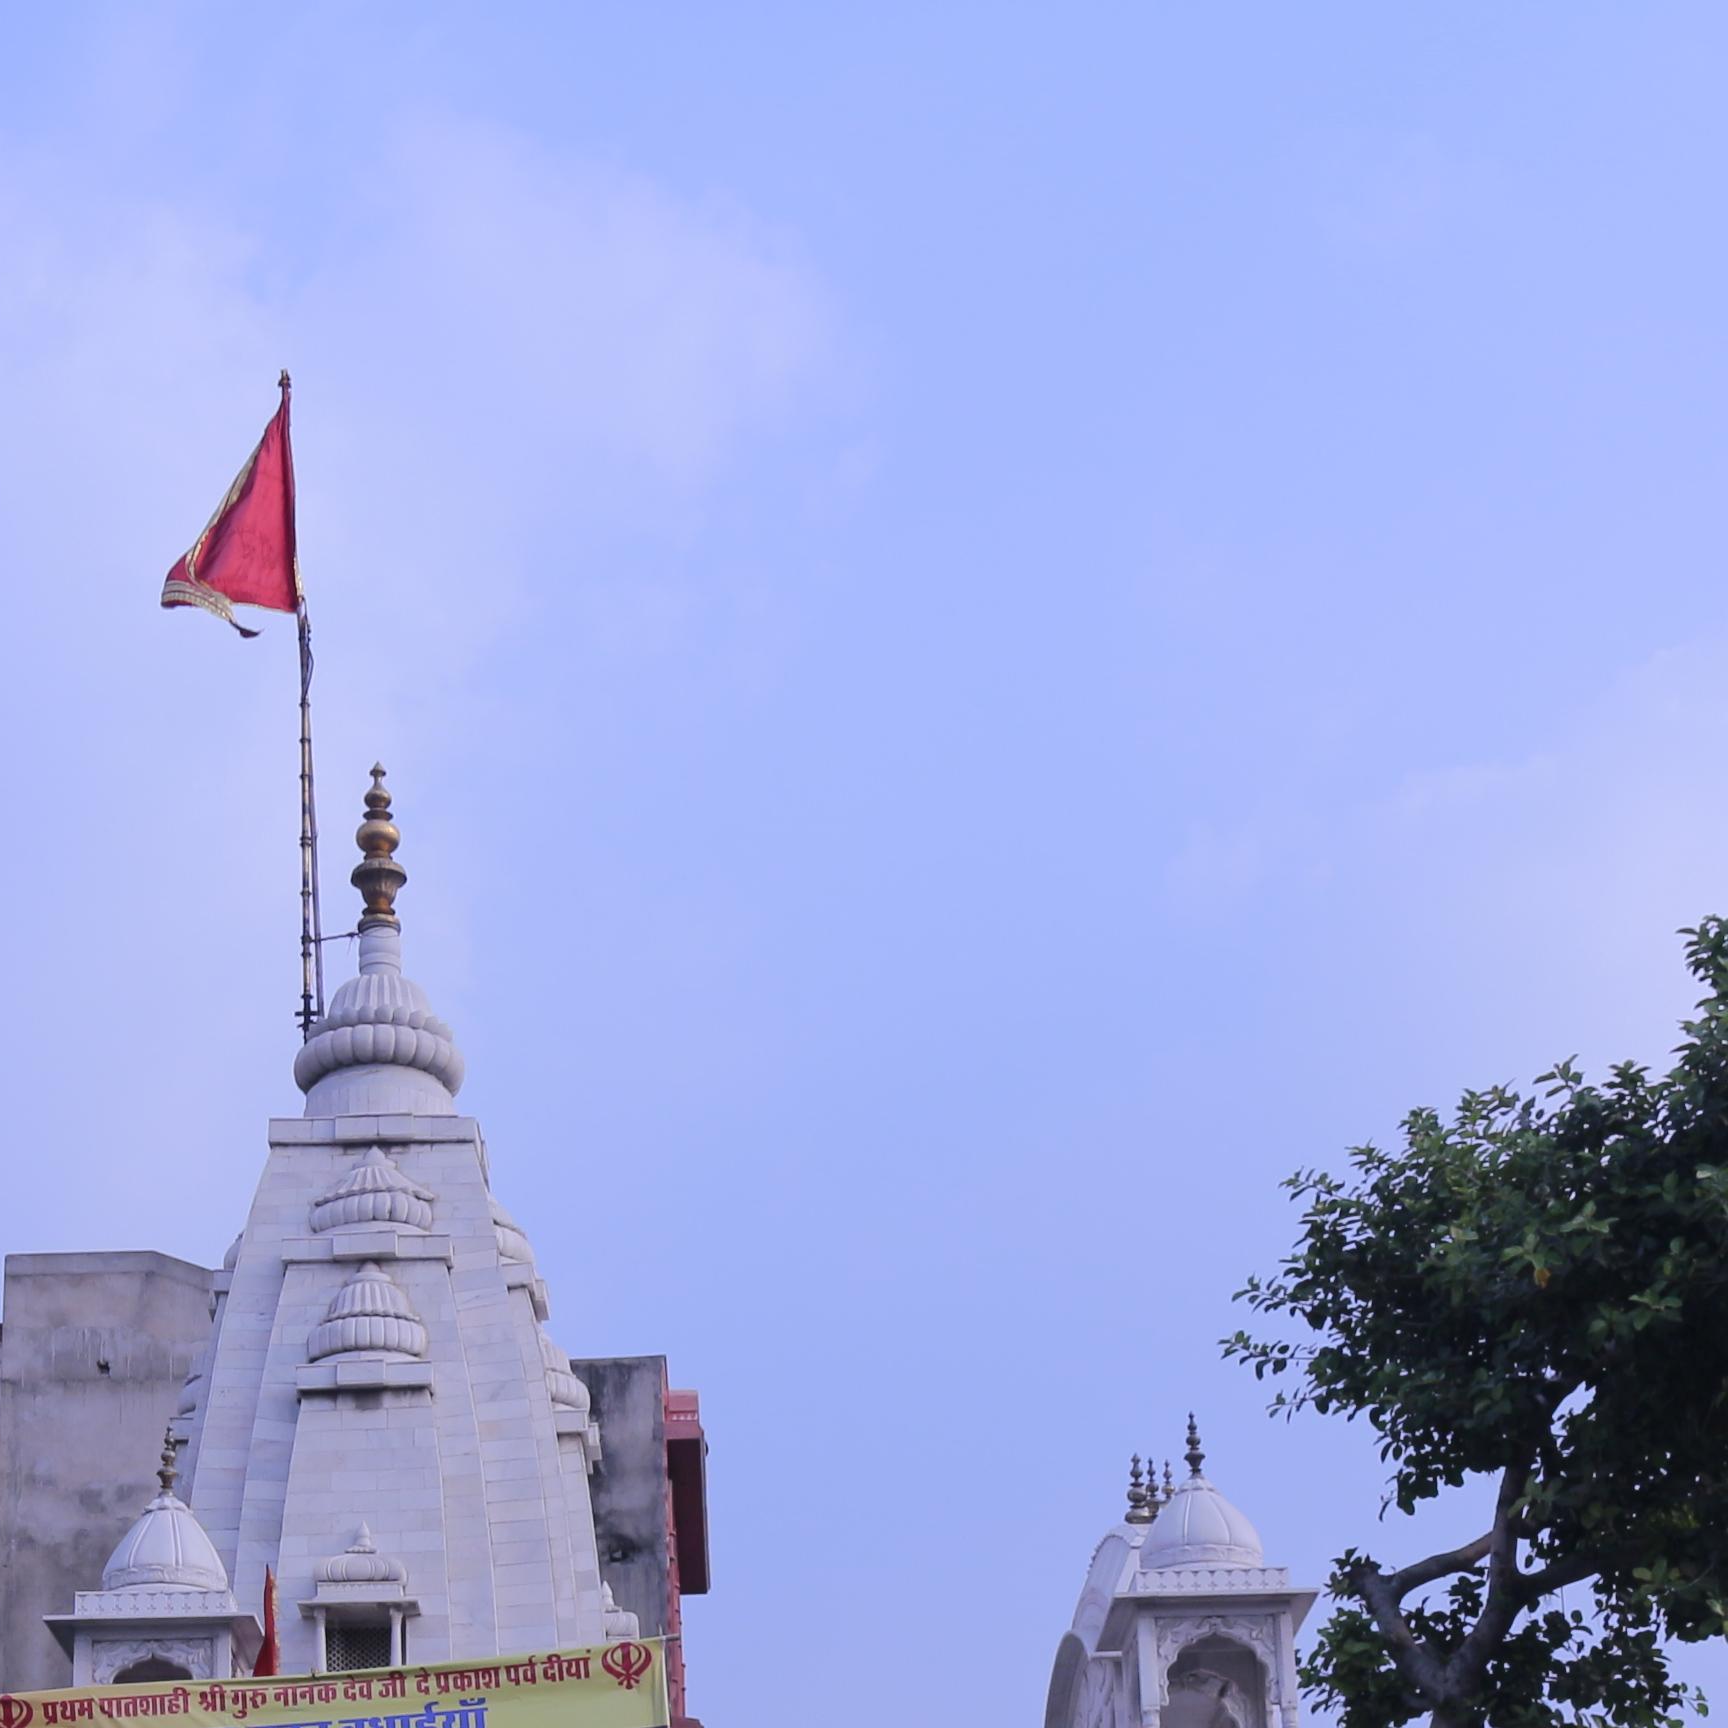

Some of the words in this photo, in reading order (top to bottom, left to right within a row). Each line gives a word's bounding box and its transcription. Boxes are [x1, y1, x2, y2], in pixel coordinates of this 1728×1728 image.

[42, 1700, 93, 1725] प्रथम
[99, 1687, 190, 1719] पातशाही
[199, 1684, 227, 1714] श्री
[232, 1688, 269, 1719] गुरु
[273, 1681, 338, 1710] नानक
[343, 1674, 373, 1701] देव
[378, 1671, 406, 1700] जी
[414, 1667, 430, 1694] दे
[436, 1666, 500, 1695] प्रकाश
[504, 1655, 537, 1687] पर्व
[542, 1649, 592, 1682] दीयां
